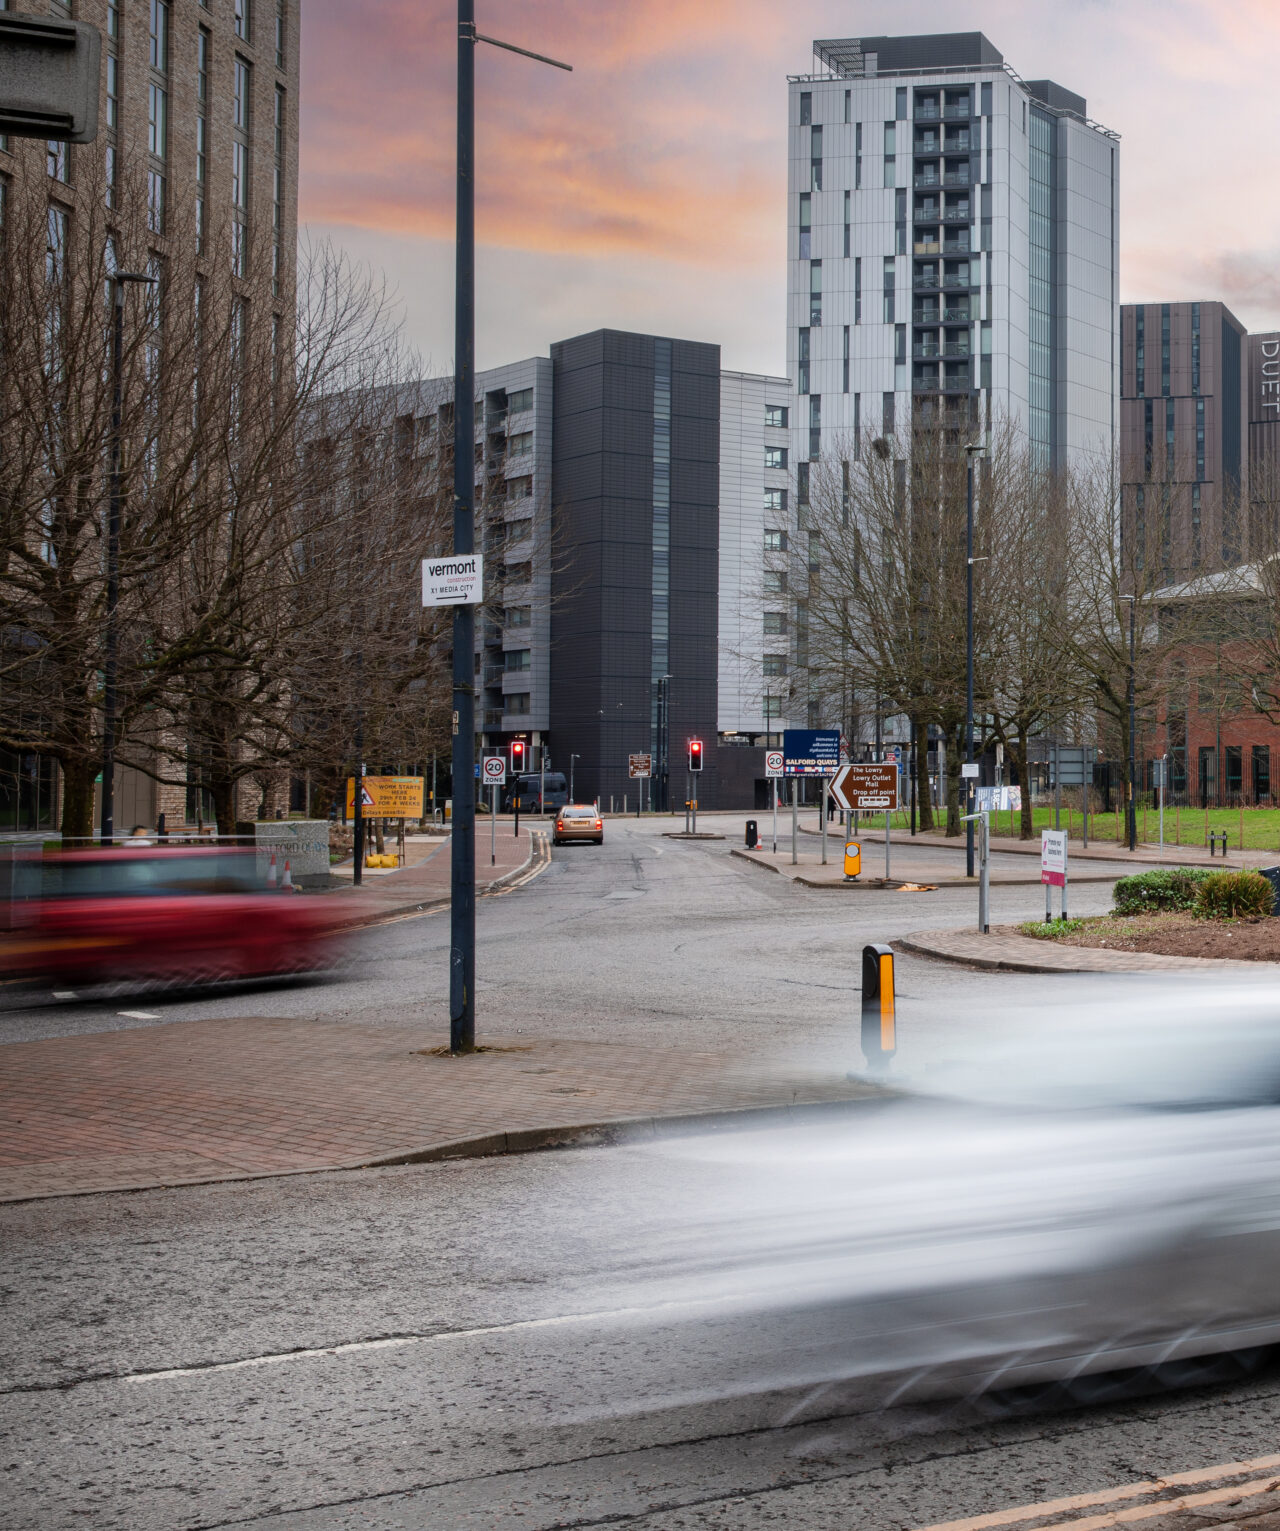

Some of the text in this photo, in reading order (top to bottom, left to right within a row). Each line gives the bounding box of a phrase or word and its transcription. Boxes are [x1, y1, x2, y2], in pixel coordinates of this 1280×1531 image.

[1262, 340, 1280, 414] DUET
[428, 559, 476, 577] vermont
[459, 584, 474, 592] CITY
[770, 757, 782, 765] 20
[488, 763, 501, 771] 20
